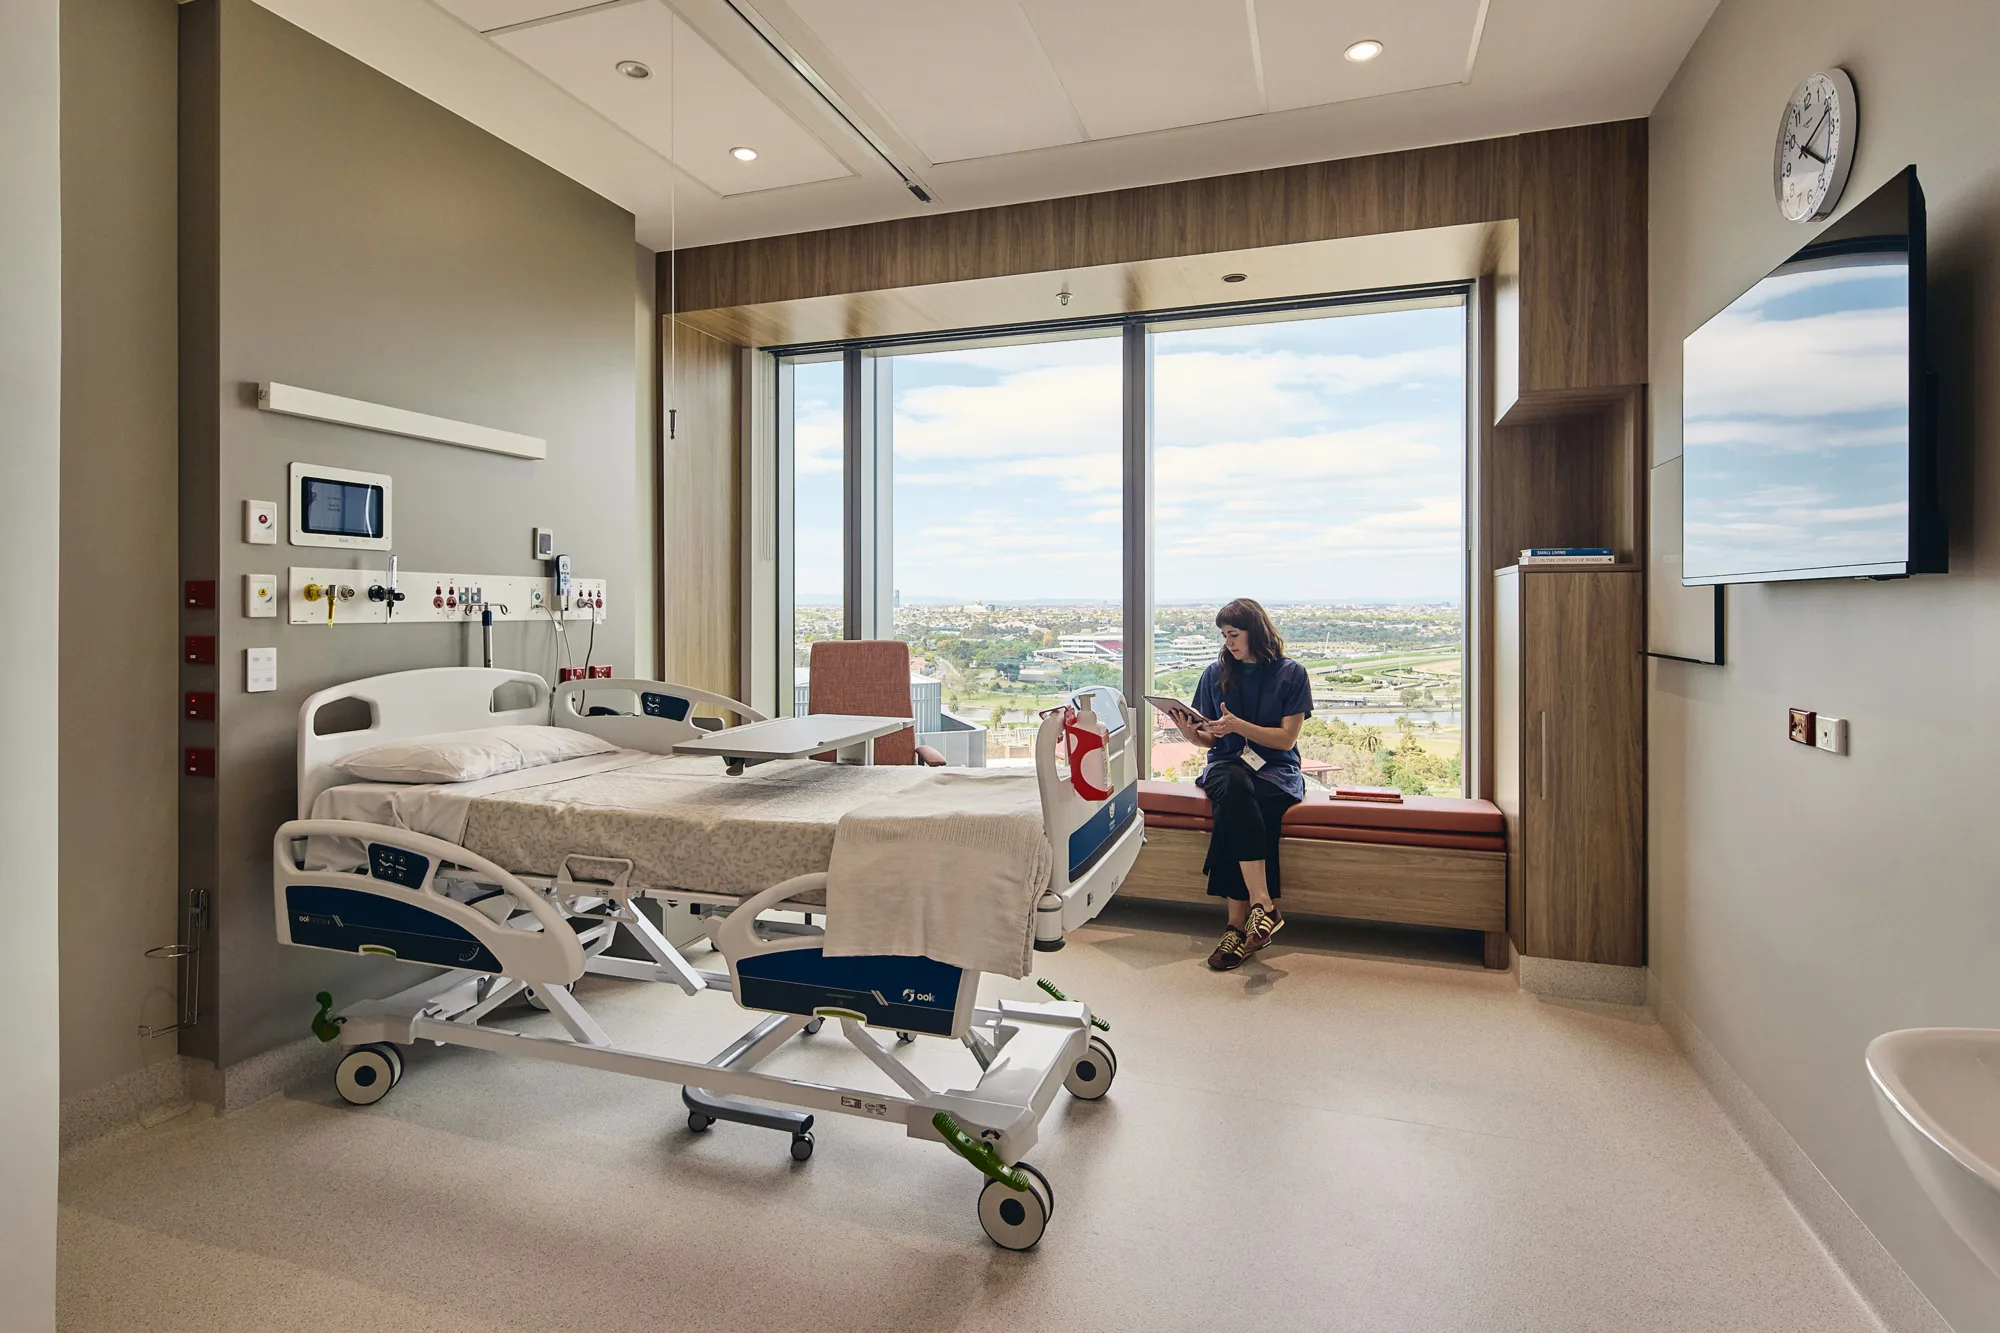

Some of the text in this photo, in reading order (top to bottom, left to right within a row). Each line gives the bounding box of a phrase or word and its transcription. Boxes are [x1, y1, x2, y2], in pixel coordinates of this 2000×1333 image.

[1803, 92, 1811, 111] 12
[1816, 87, 1820, 103] 1
[1795, 110, 1801, 127] 11
[1830, 118, 1836, 135] 3
[1788, 134, 1795, 152] 10
[1786, 162, 1792, 178] 9
[1789, 182, 1795, 198] 8
[1807, 188, 1814, 205] 6
[1796, 192, 1802, 208] 7
[916, 992, 936, 1002] ook
